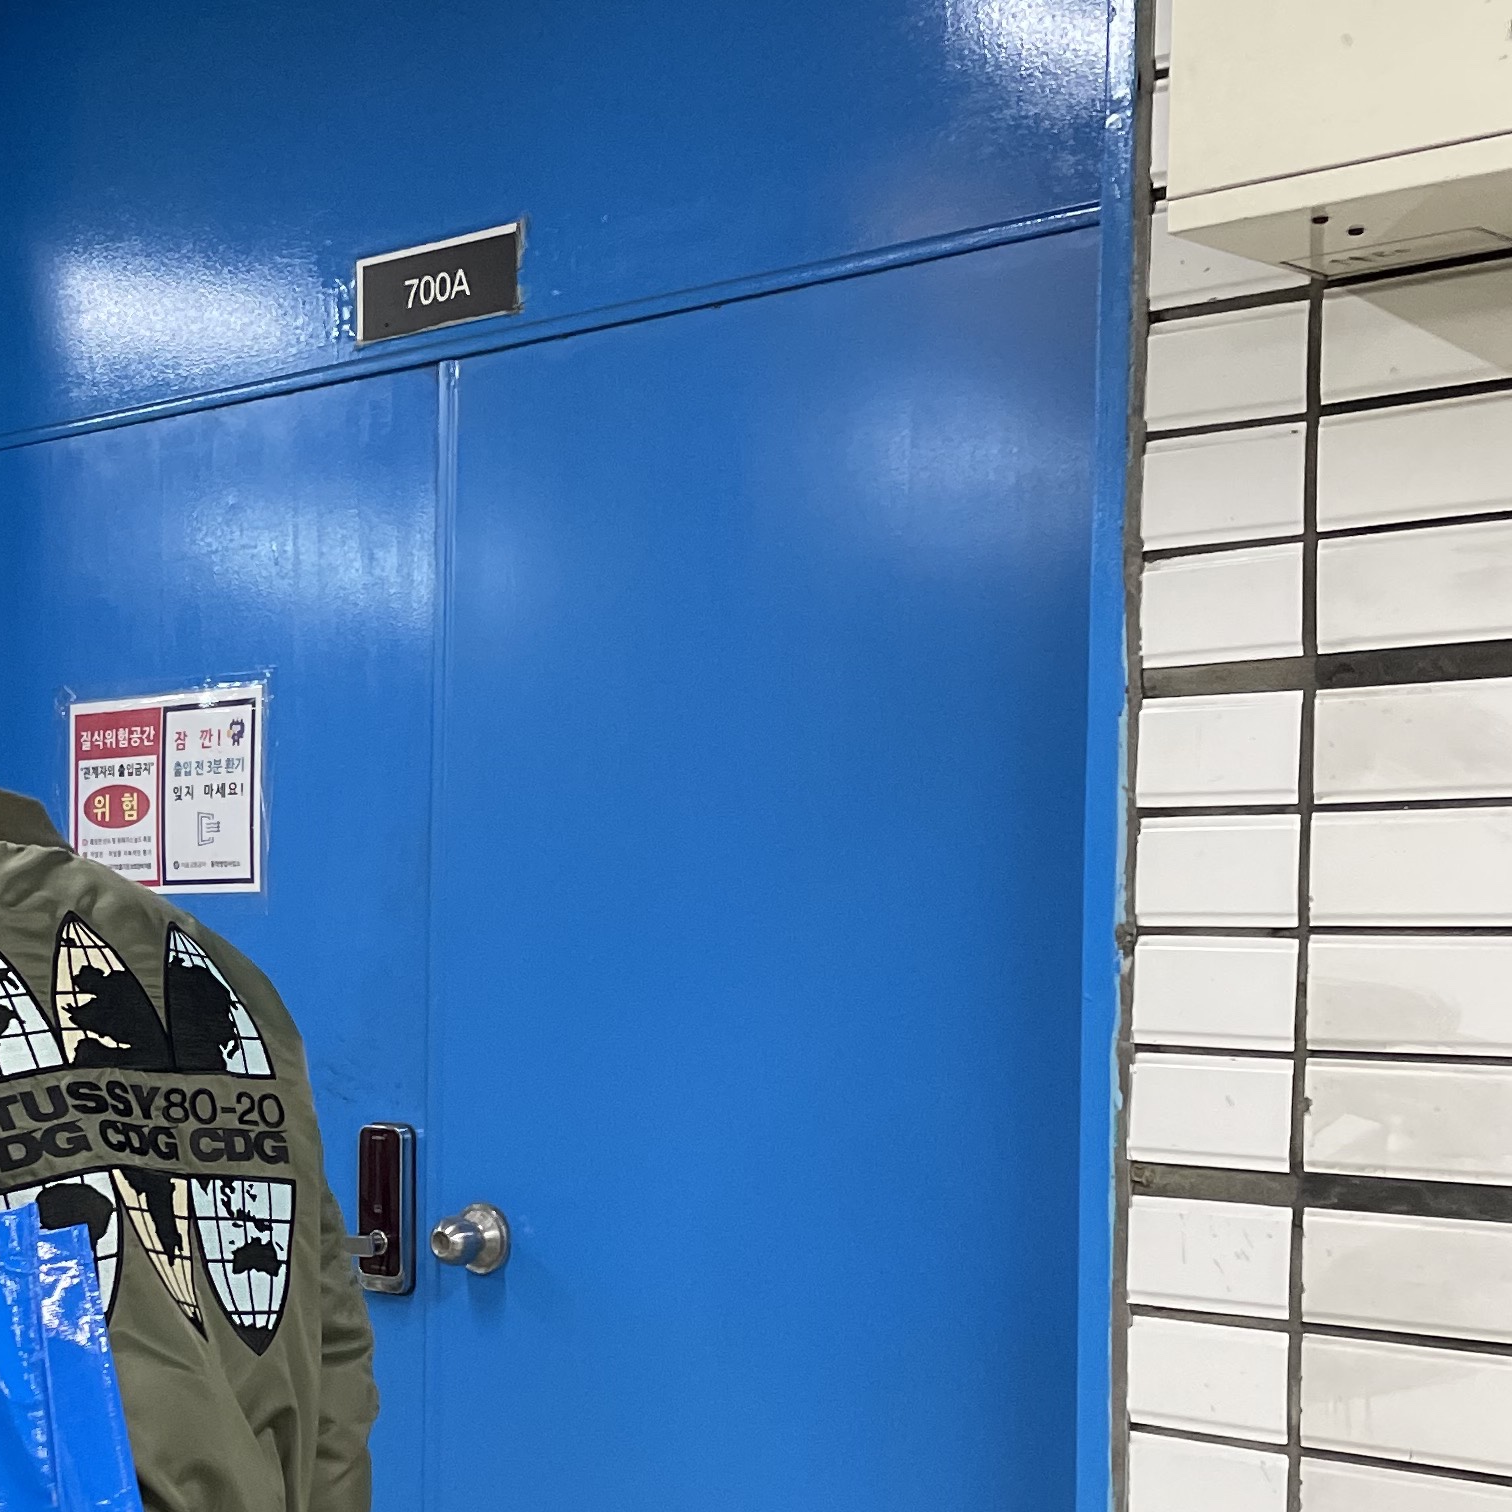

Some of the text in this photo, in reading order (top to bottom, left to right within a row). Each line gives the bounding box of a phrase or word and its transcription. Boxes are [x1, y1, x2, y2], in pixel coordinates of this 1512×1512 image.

[404, 268, 471, 309] 700A
[80, 725, 156, 751] 질식위험공간
[173, 782, 245, 802] 잊지 마세요!
[162, 1087, 285, 1129] 80-20
[99, 1119, 180, 1162] CDG
[189, 1127, 290, 1165] CDG
